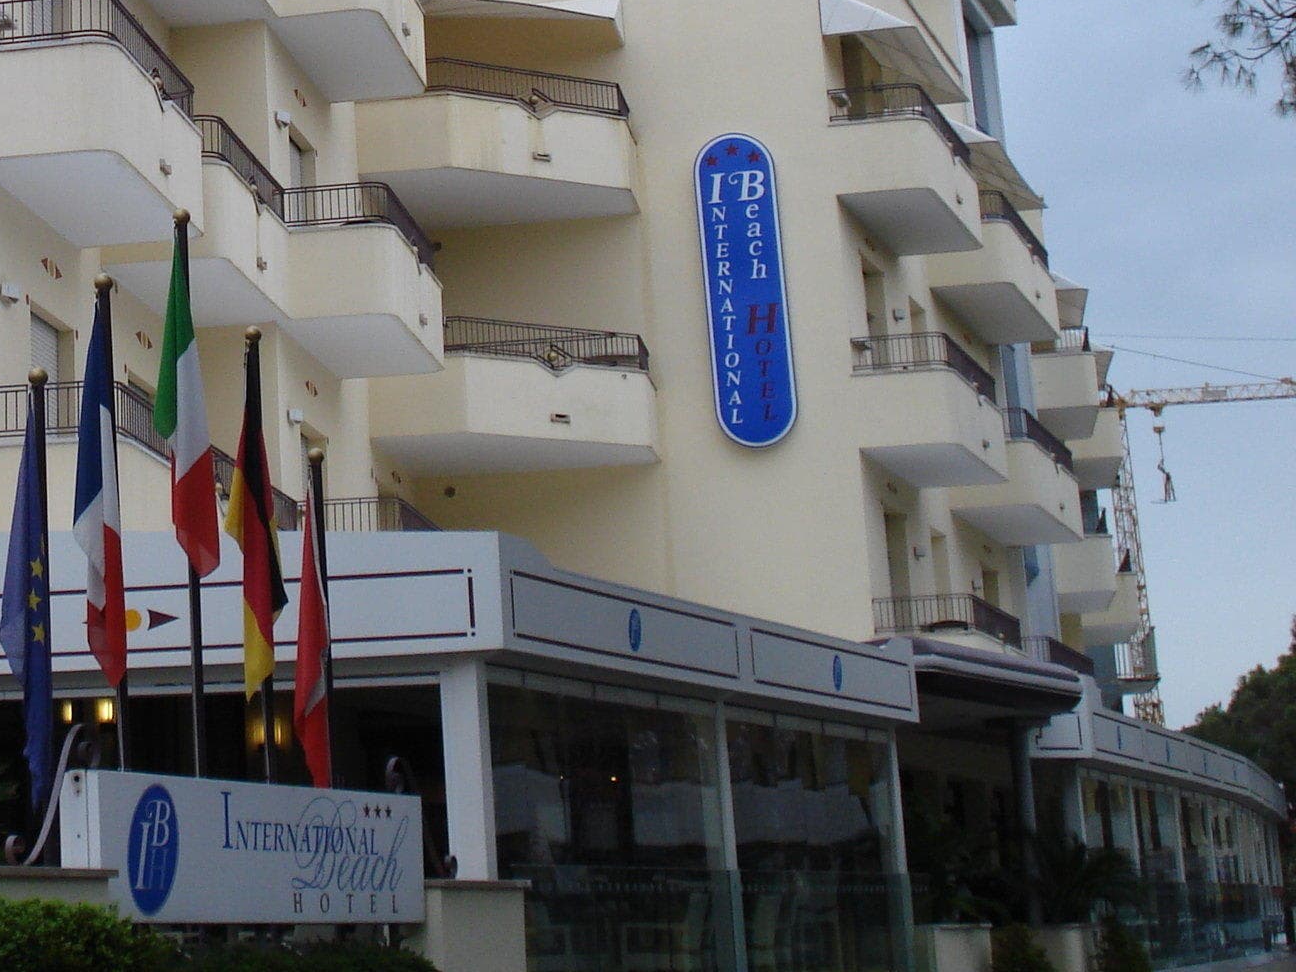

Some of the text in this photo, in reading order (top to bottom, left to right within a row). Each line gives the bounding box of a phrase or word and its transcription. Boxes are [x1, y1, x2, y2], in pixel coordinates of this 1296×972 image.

[728, 169, 767, 280] Beach
[708, 172, 744, 425] INTERNATIONAL
[745, 302, 780, 423] HOTEL
[220, 791, 379, 857] INTERNATIONAL
[291, 796, 409, 892] Beach
[293, 892, 399, 914] HOTEL
